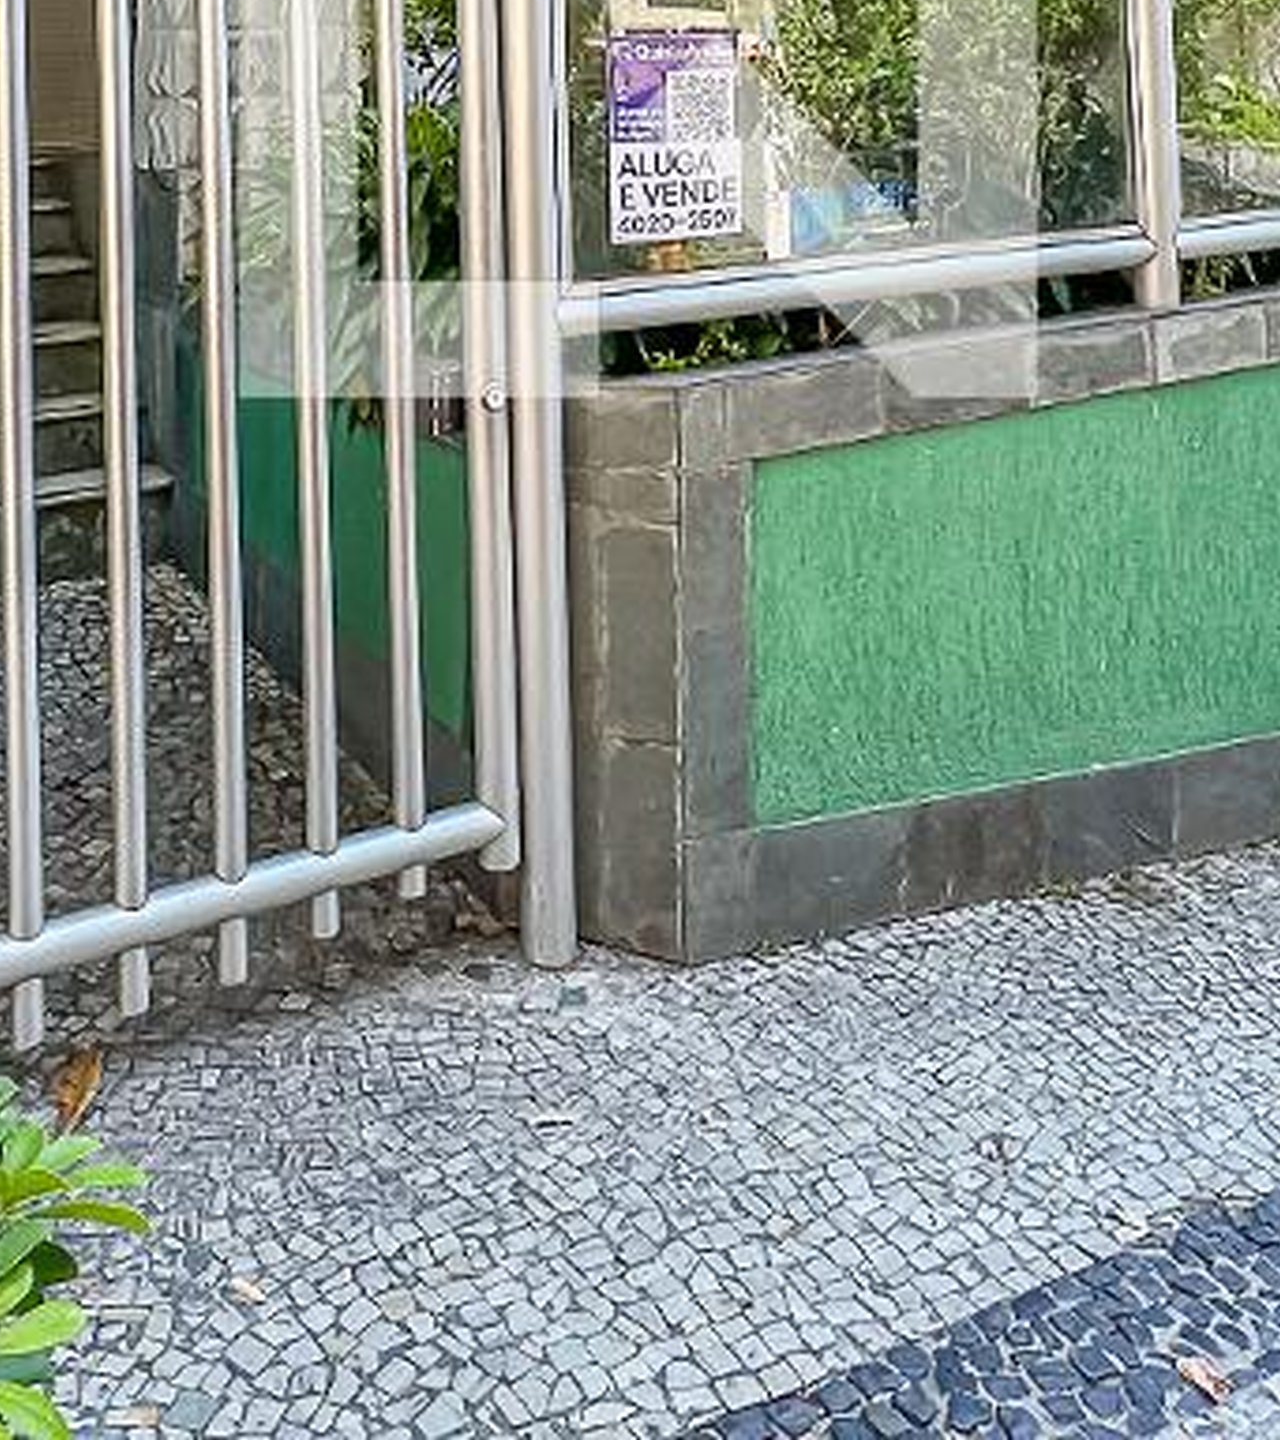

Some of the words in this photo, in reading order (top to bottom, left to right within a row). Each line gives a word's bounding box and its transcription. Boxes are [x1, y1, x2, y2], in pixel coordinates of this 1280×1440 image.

[618, 151, 716, 178] ALUGA
[620, 183, 636, 210] E
[642, 178, 737, 208] VENDE
